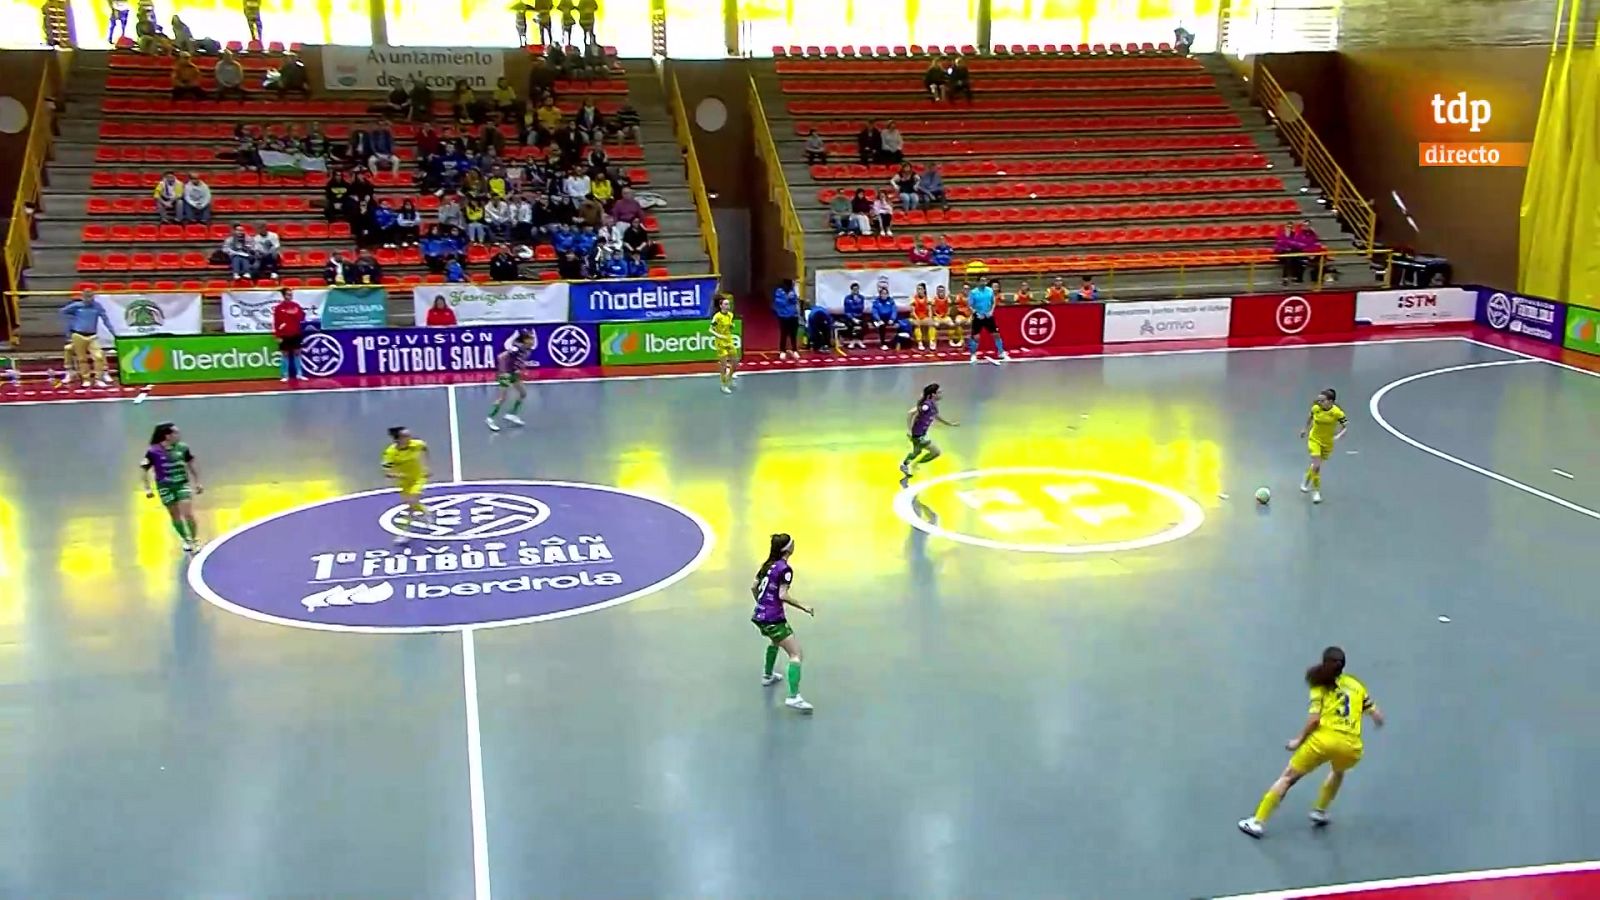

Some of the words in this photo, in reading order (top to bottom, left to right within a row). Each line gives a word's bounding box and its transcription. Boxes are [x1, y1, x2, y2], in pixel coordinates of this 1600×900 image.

[377, 330, 493, 345] DIVISIÓN
[645, 332, 741, 353] Iberdroa
[172, 346, 282, 370] Iberdrola
[378, 345, 447, 374] FÚTBOL
[451, 345, 496, 370] SALA
[518, 543, 613, 565] SALA
[405, 571, 623, 599] Iberdrola
[1335, 692, 1350, 717] 3
